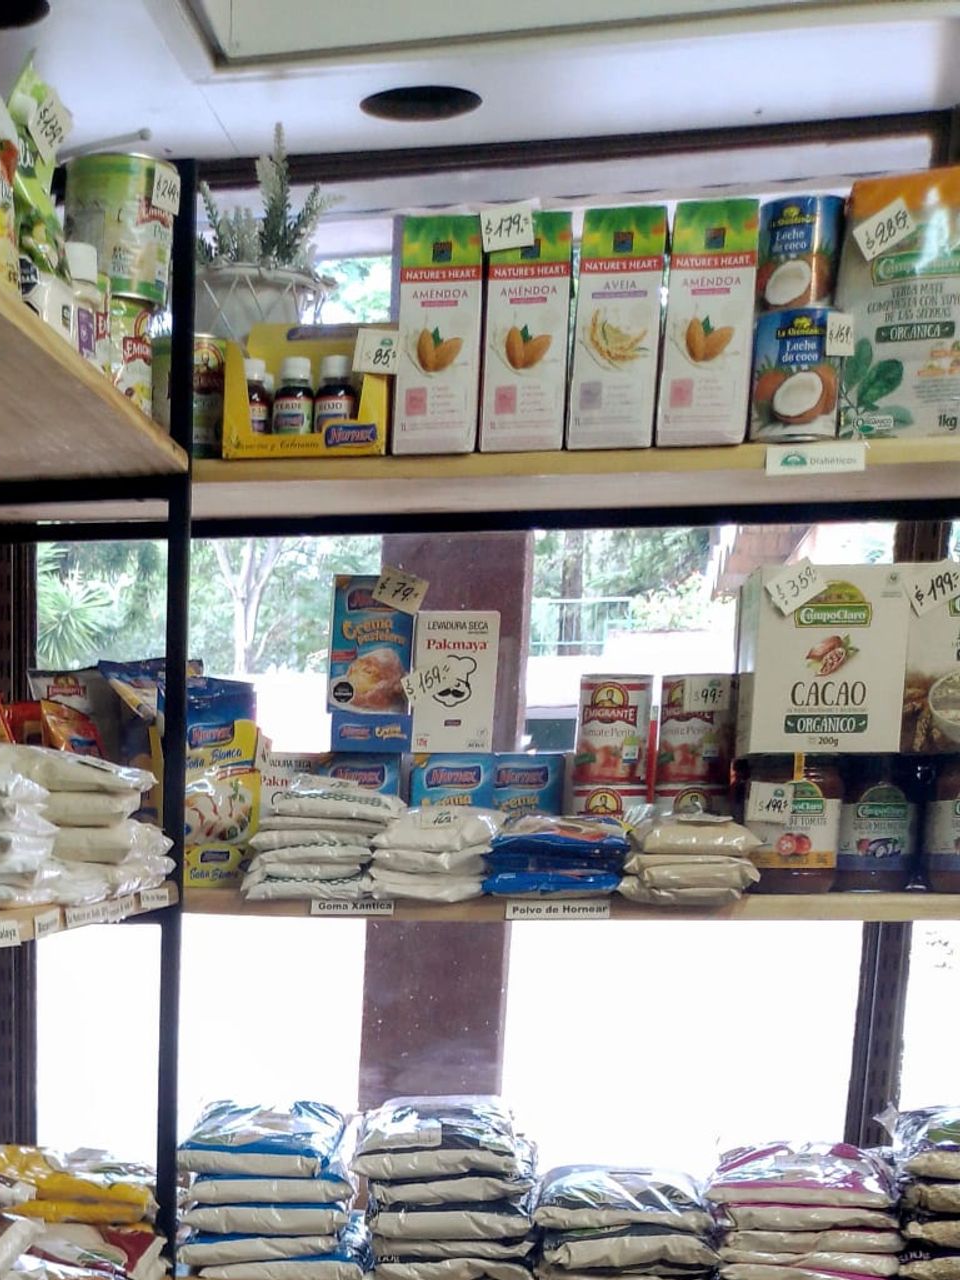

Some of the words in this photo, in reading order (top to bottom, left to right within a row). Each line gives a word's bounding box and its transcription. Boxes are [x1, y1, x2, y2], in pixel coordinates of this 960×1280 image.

[584, 261, 626, 271] NATURE'S
[628, 259, 659, 270] HEART
[676, 257, 719, 268] NATURE'S
[721, 255, 751, 266] HEART
[493, 268, 534, 279] NATURE'S
[536, 266, 566, 277] HEART
[786, 340, 817, 351] Leche
[795, 353, 819, 362] coco
[799, 607, 866, 625] CampoClaro
[427, 620, 468, 631] LEVADURA
[468, 620, 489, 631] SECA
[426, 638, 488, 654] Pakmaya
[790, 681, 867, 707] CACAO
[818, 736, 839, 747] 200g
[318, 901, 349, 912] Goma
[512, 905, 544, 915] Polvo
[546, 904, 560, 914] de
[562, 902, 608, 914] Hornear
